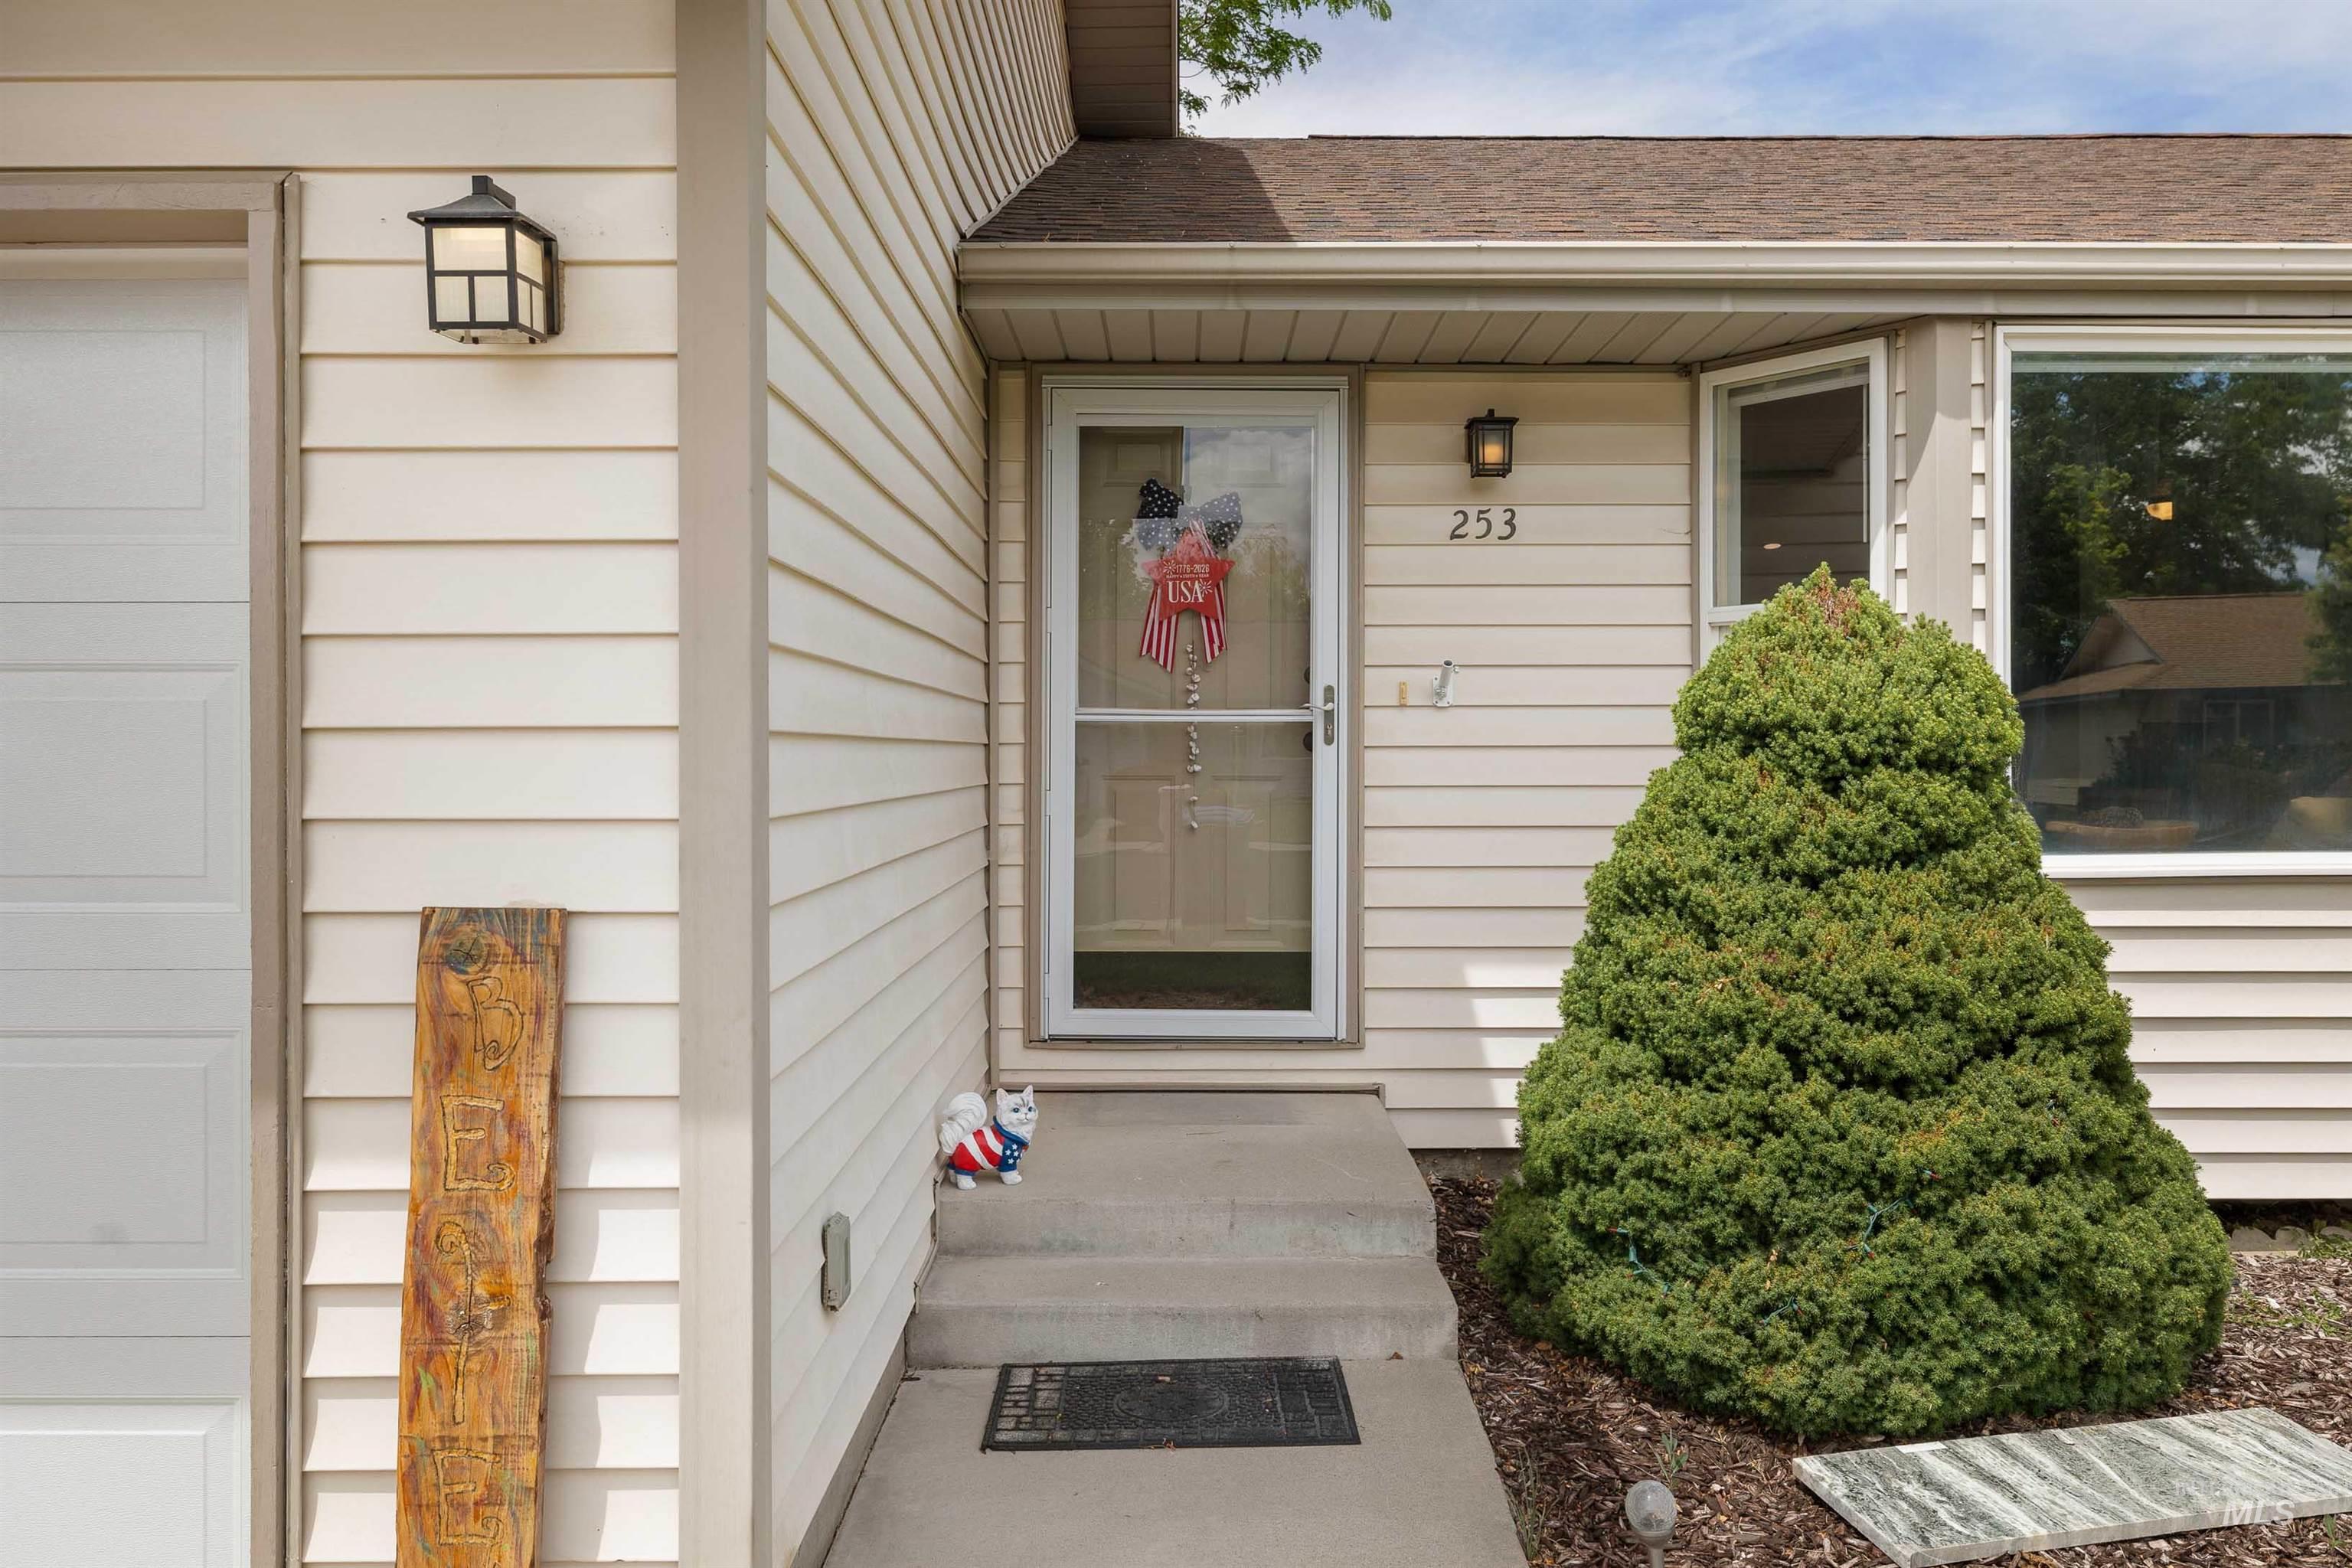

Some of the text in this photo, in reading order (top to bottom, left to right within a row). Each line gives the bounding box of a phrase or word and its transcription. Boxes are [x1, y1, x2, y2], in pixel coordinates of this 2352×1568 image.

[1449, 508, 1517, 541] 253
[1176, 564, 1210, 573] 1776-2026
[1166, 580, 1204, 603] USA
